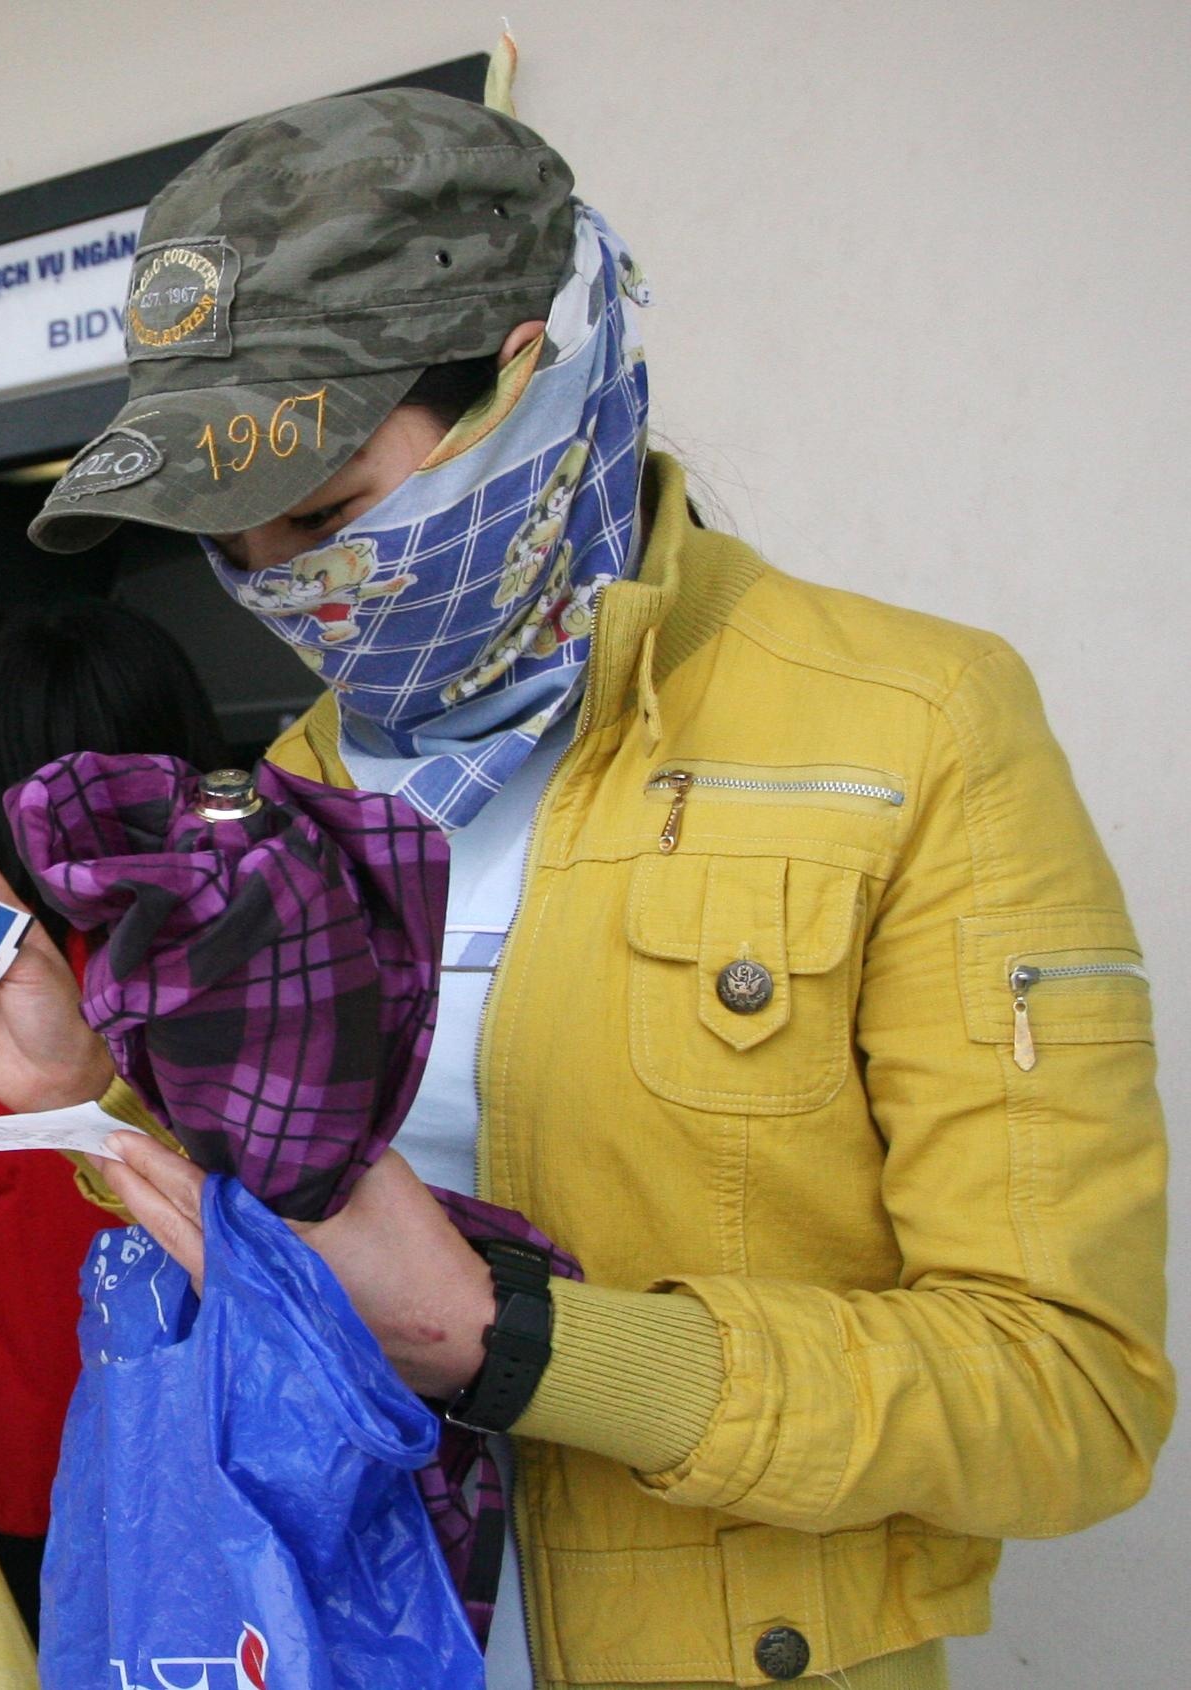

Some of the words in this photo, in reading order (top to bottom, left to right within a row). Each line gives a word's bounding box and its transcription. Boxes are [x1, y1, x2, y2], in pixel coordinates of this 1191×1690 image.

[37, 250, 66, 284] VỤ
[72, 230, 137, 271] NGÂN
[196, 385, 326, 480] 1967
